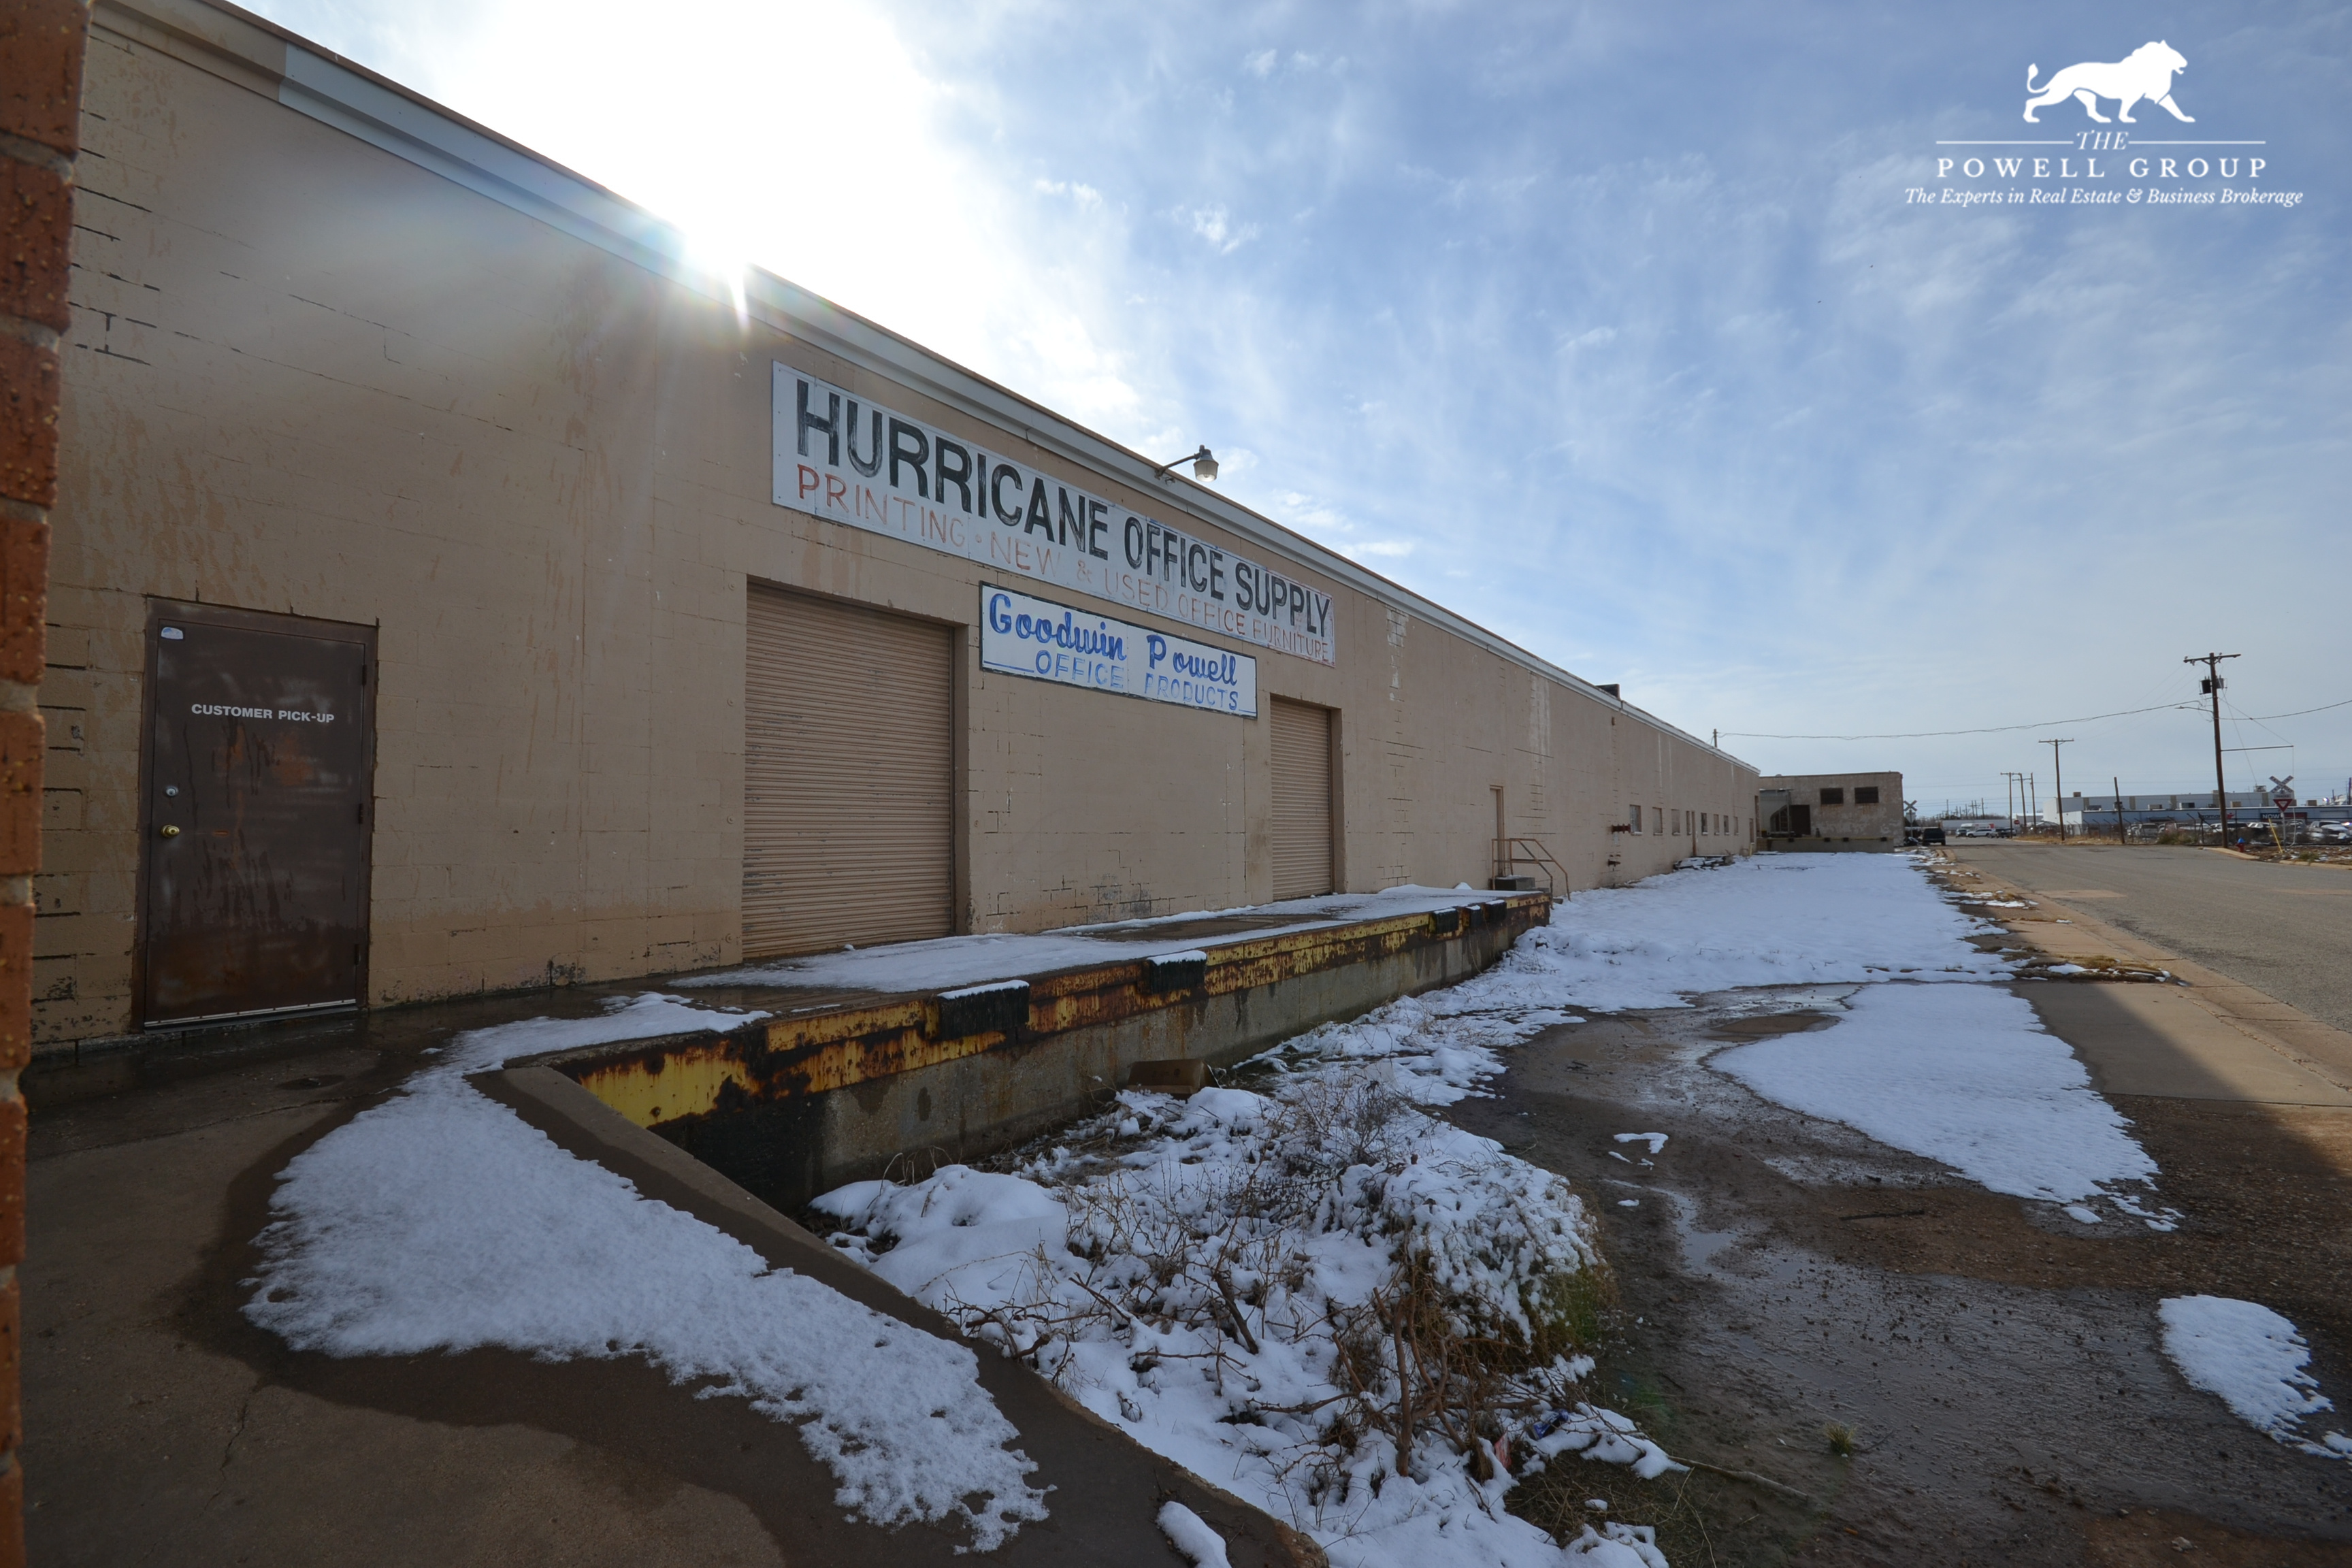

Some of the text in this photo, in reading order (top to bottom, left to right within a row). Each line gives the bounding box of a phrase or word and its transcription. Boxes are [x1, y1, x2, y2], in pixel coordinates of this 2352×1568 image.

[797, 378, 1330, 637] HURRICANE OFFICE SUPPLY
[797, 463, 1329, 662] PRINTING NEW & USED OFFICE FURNITURE
[989, 593, 1238, 685] Goodwin Powell
[1035, 650, 1239, 710] OFFICE PRODUCTS
[191, 704, 335, 723] CUSTOMER PICK-UP
